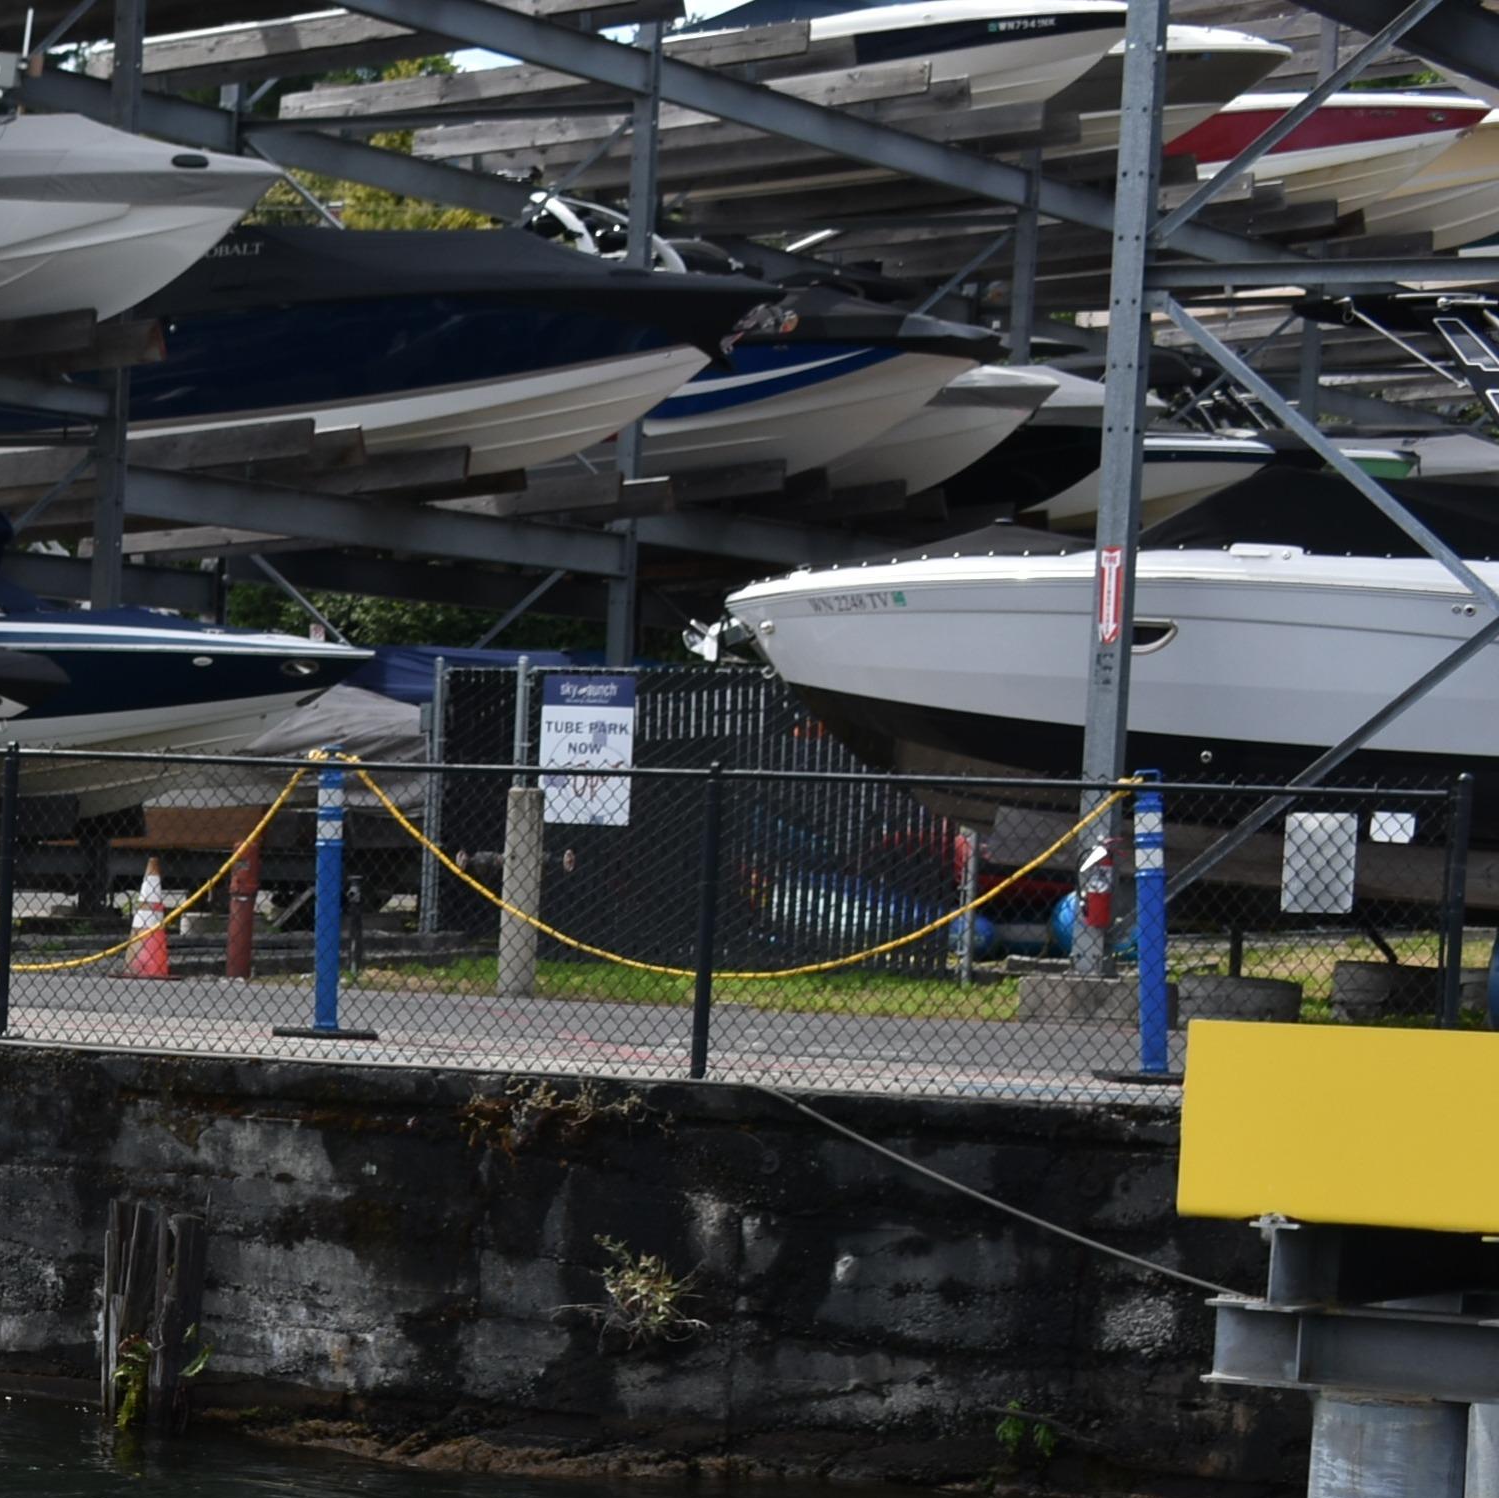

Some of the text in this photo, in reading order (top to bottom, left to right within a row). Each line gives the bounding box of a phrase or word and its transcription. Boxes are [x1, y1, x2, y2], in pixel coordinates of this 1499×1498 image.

[205, 243, 264, 258] OBALT
[545, 721, 630, 735] TUBE PARK
[567, 742, 602, 755] NOW
